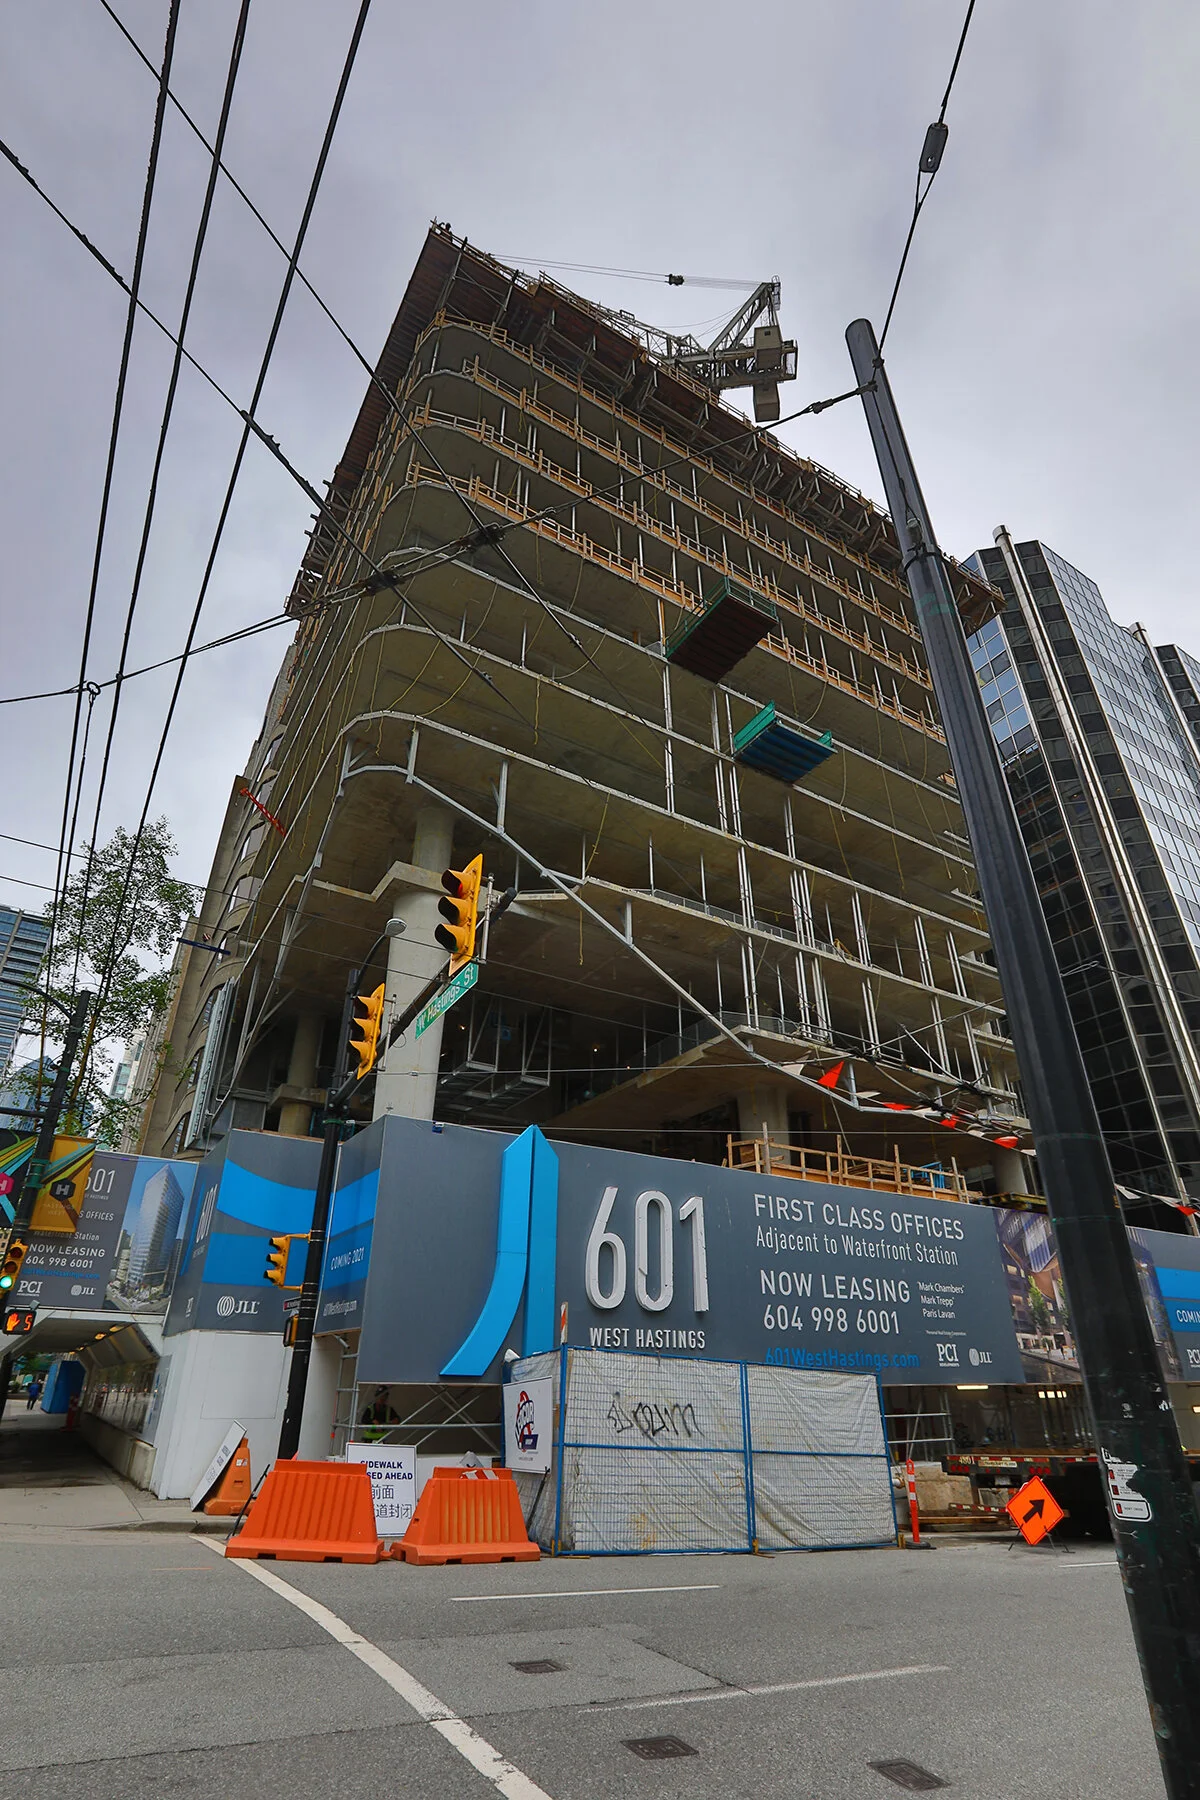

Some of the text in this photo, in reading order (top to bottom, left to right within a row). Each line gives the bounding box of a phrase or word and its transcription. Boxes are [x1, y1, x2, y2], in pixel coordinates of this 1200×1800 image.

[419, 965, 475, 1030] W Hastings St
[86, 1211, 114, 1221] OFFICES
[754, 1194, 964, 1241] FIRST CLASS OFFICES
[74, 1232, 99, 1241] Station
[29, 1243, 105, 1257] NOW LEASING
[585, 1186, 709, 1312] 601
[756, 1225, 959, 1266] Adjacent to Waterfront Station
[26, 1256, 93, 1269] 604 998 6001
[18, 1281, 42, 1293] PCI
[81, 1287, 95, 1295] JLL
[760, 1269, 910, 1303] NOW LEASING
[234, 1300, 258, 1314] JLL
[920, 1295, 936, 1305] Mark
[764, 1304, 900, 1334] 604 998 6001
[922, 1308, 955, 1318] Paris Lavan
[23, 1315, 33, 1331] 5
[590, 1327, 706, 1349] WEST HASTINGS
[765, 1347, 920, 1371] 601WestHastings.com
[936, 1343, 959, 1361] PCI
[979, 1351, 992, 1363] JLL
[367, 1472, 413, 1480] SED AHEAD
[375, 1504, 412, 1519] 道封闭
